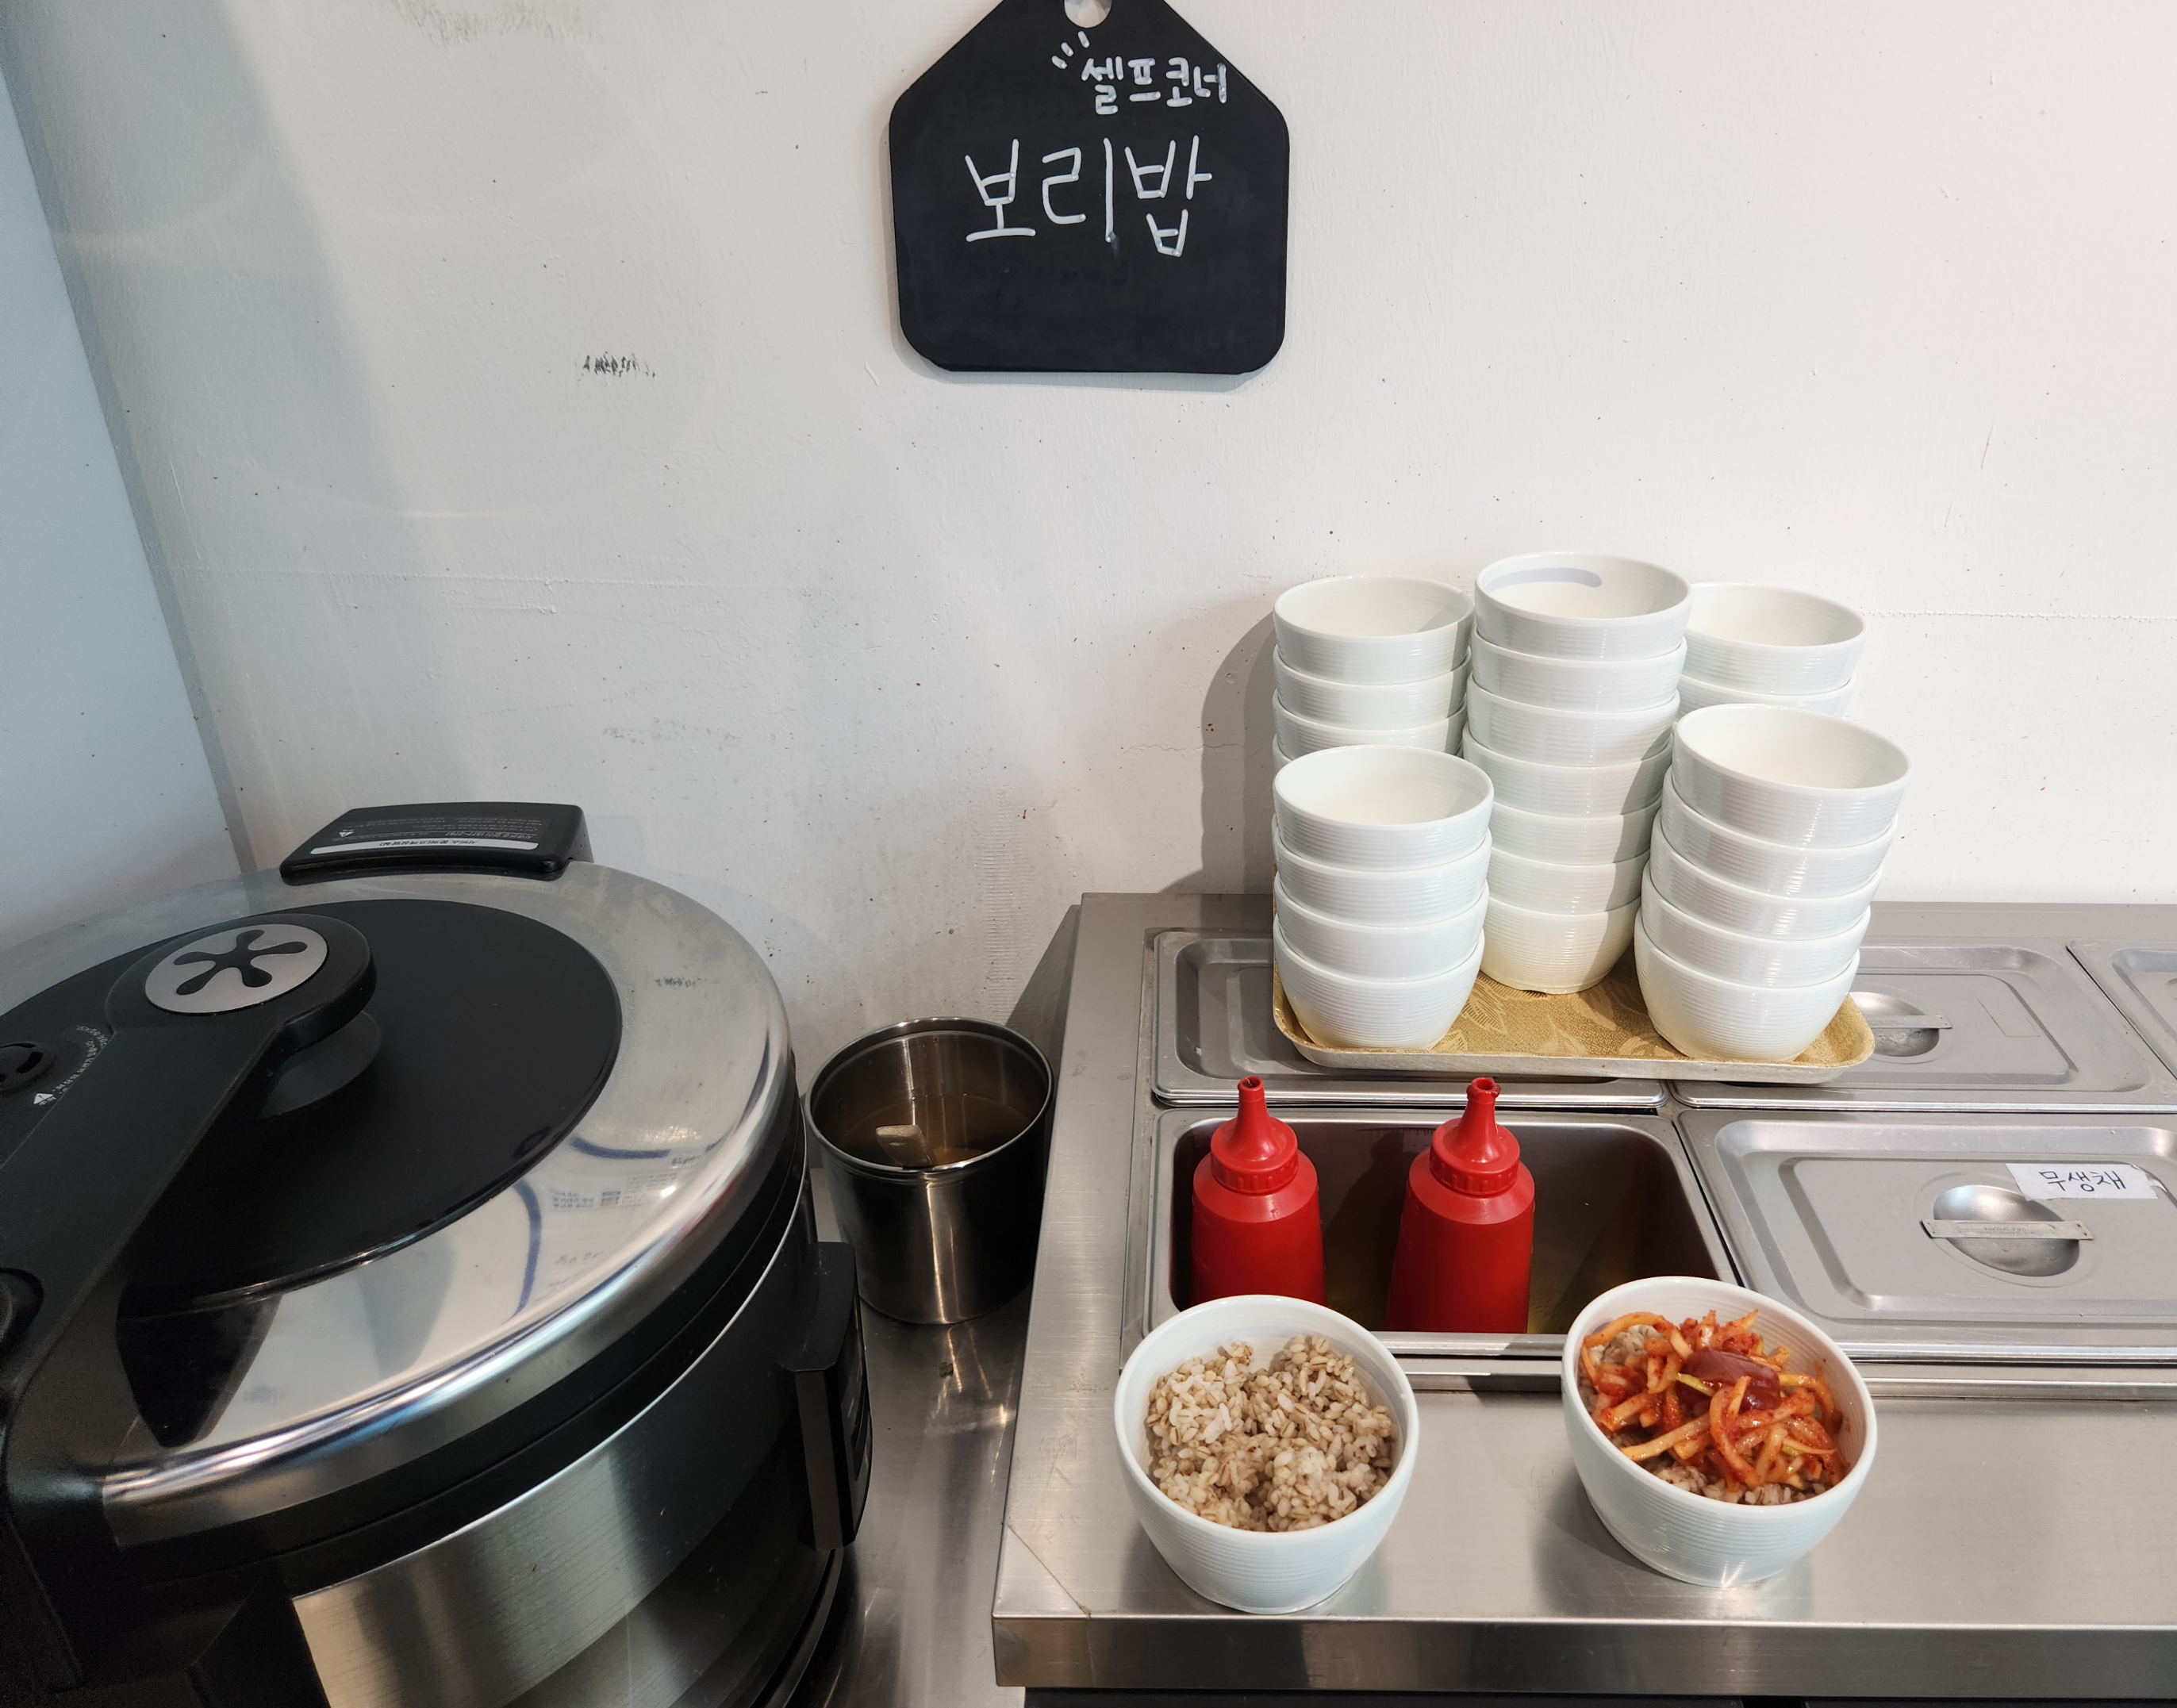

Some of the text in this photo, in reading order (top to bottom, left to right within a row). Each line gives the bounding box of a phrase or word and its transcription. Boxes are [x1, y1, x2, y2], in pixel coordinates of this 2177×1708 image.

[1081, 56, 1227, 115] 셀프코너
[965, 135, 1213, 257] 보리밥
[2038, 1170, 2127, 1192] 무생채
